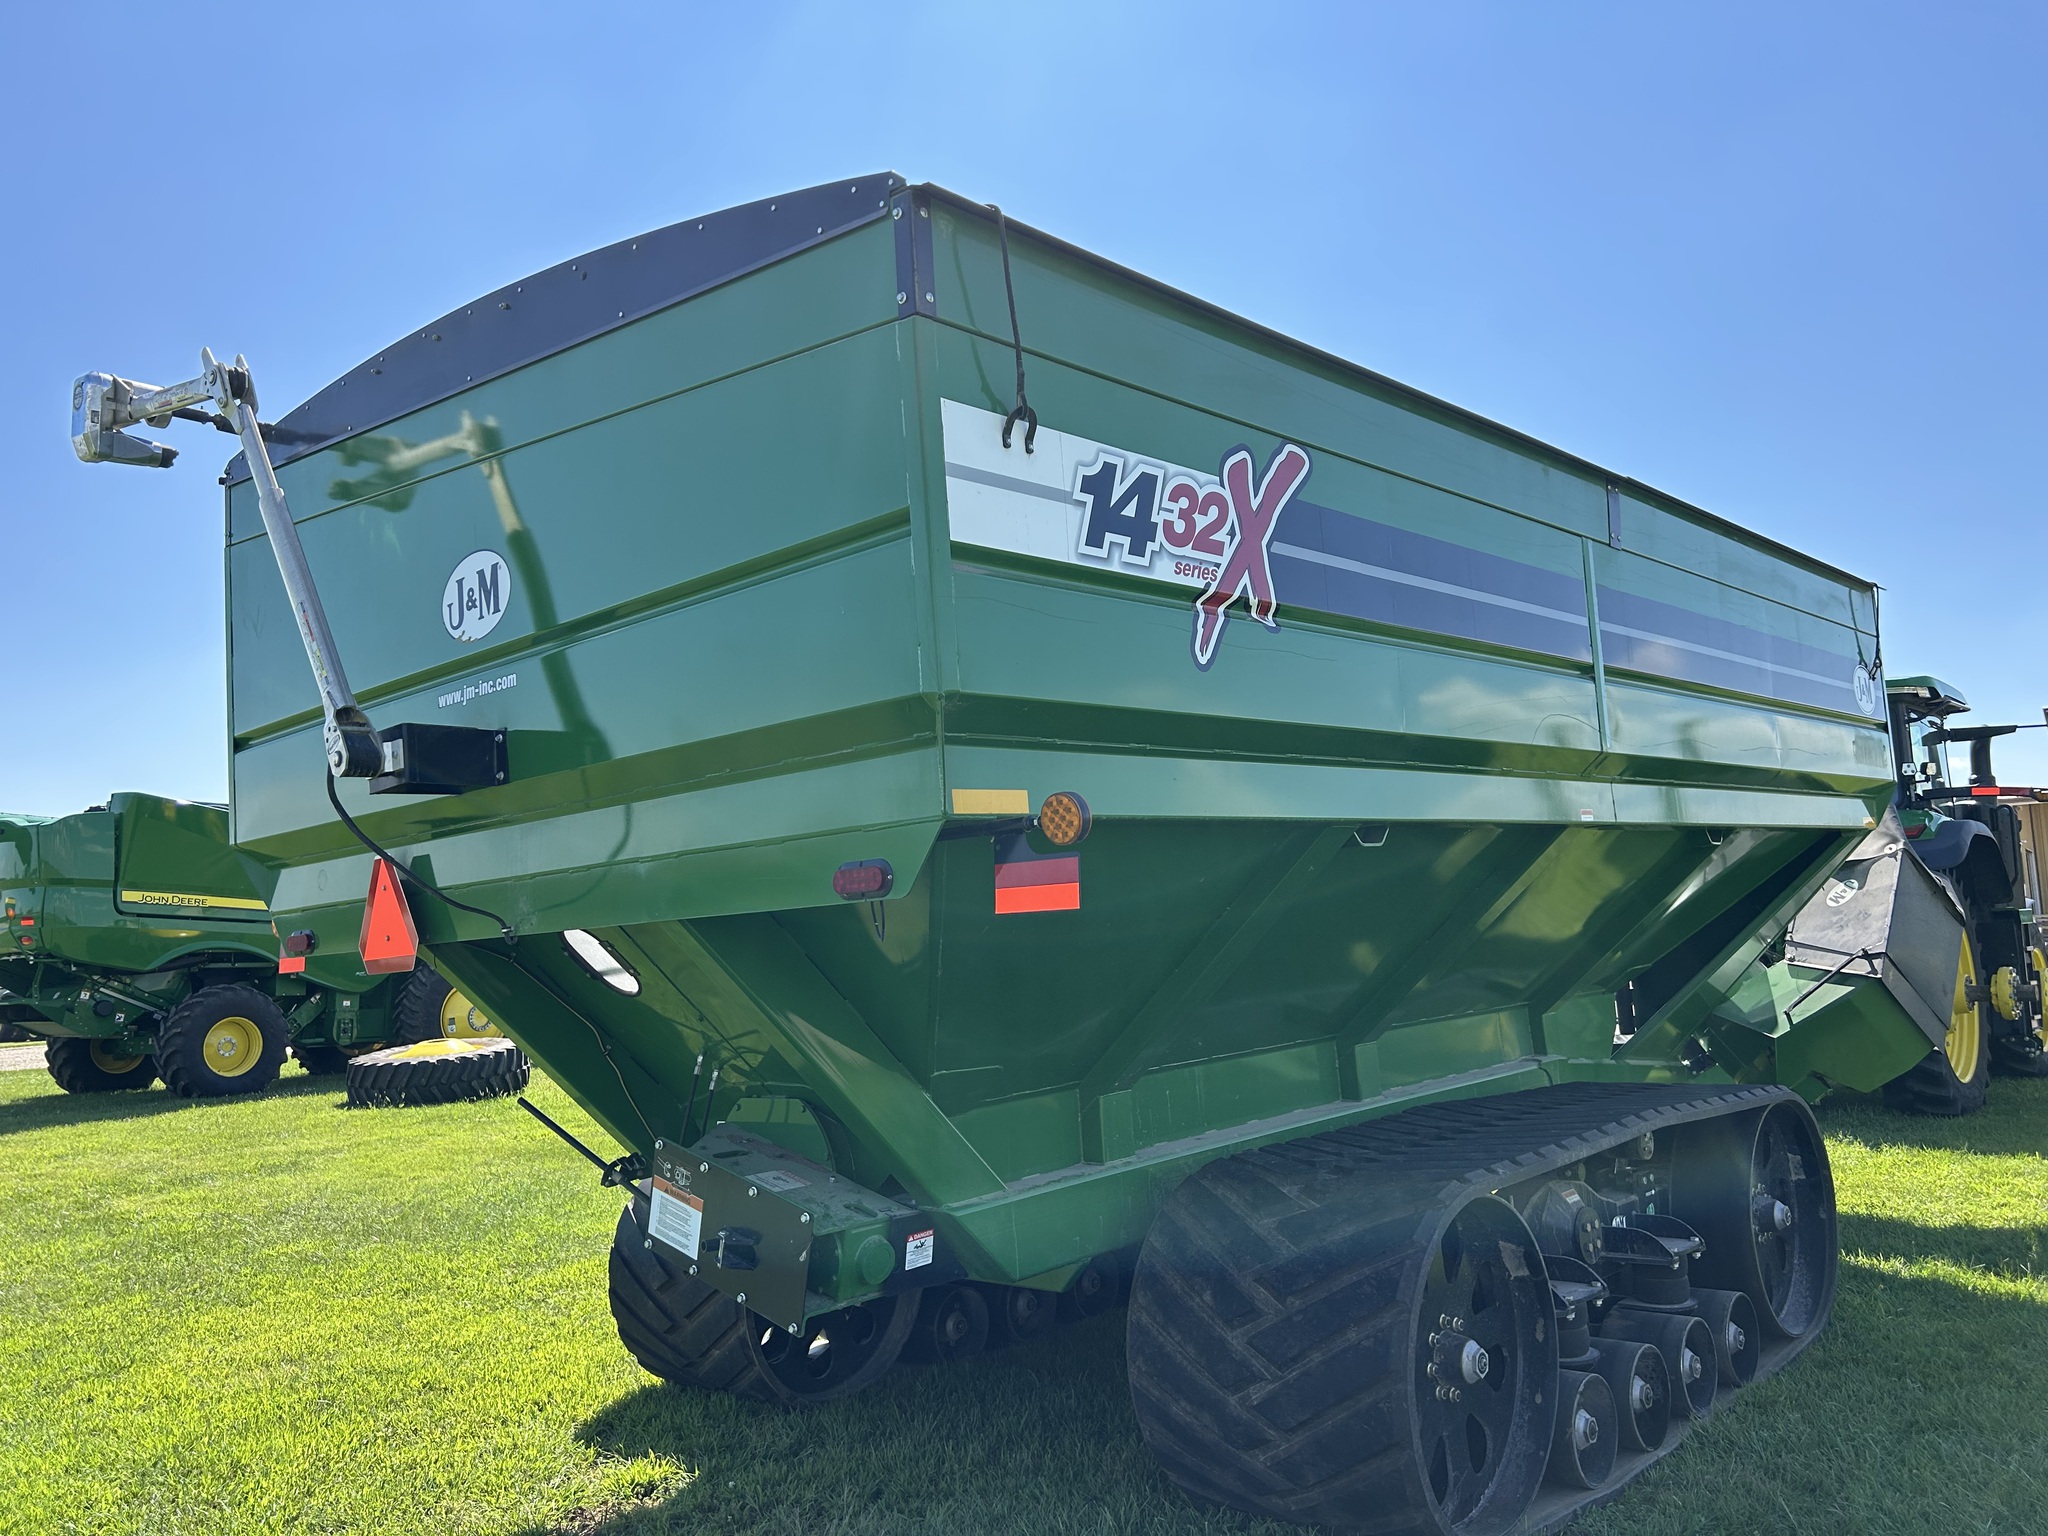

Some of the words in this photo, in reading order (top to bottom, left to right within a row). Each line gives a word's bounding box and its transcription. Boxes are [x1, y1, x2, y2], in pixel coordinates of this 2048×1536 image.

[1174, 561, 1218, 582] series
[447, 562, 501, 631] J&M
[438, 673, 517, 708] www.jm-inc.com
[138, 893, 169, 904] JOHN
[171, 895, 208, 906] DEERE
[913, 1230, 933, 1240] DANGER
